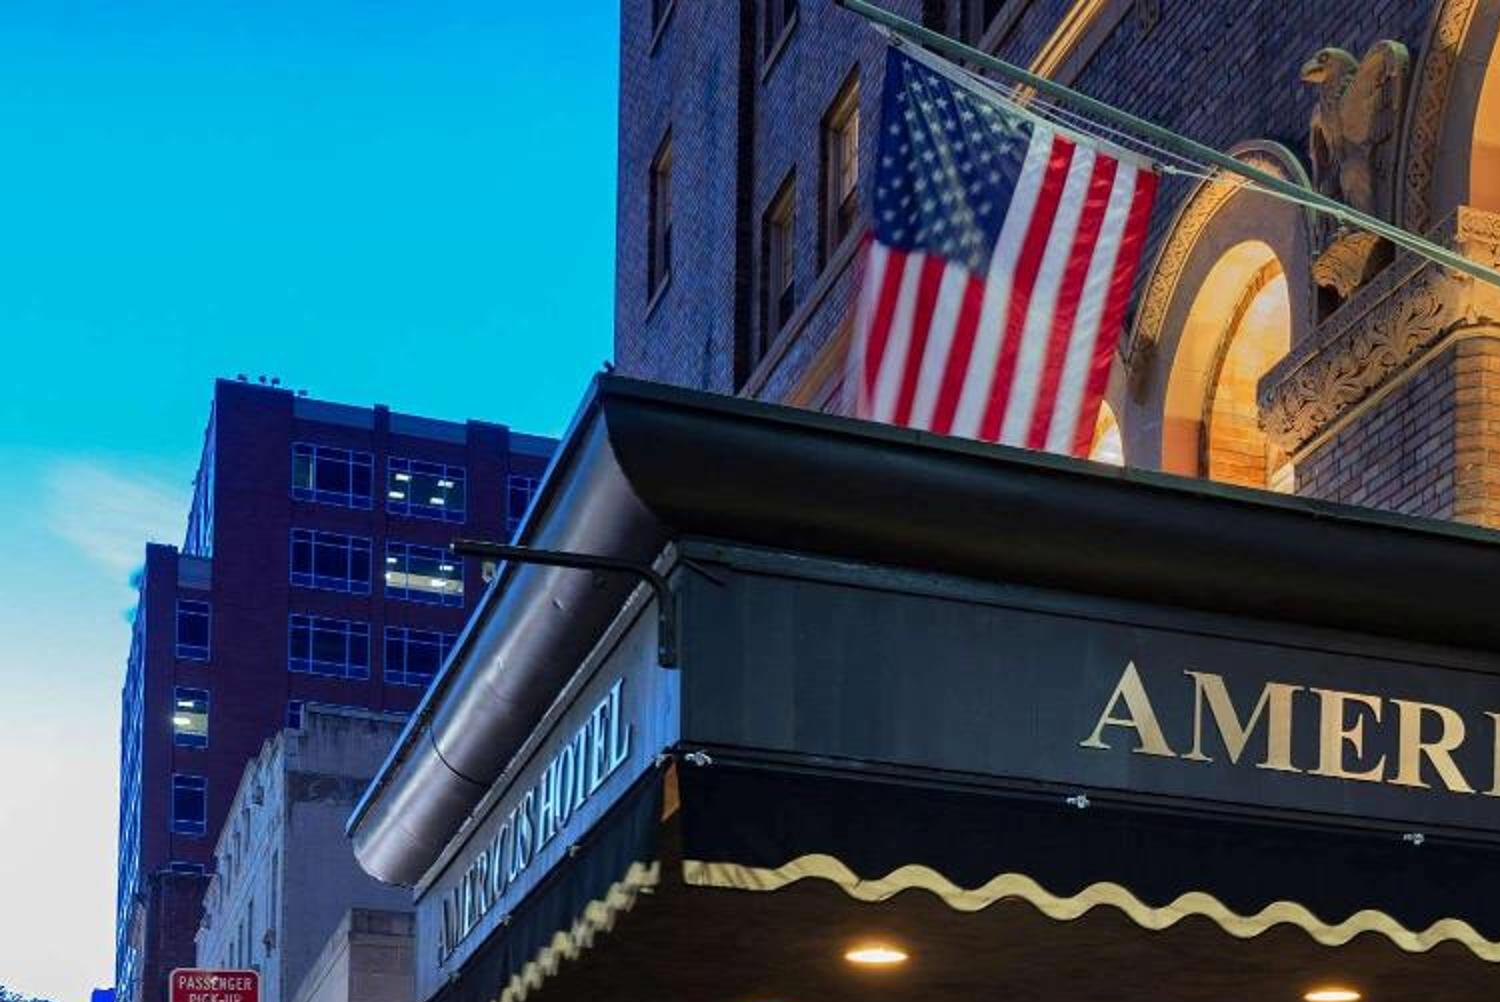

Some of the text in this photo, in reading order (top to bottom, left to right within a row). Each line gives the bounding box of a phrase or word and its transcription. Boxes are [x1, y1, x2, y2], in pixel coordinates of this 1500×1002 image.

[438, 677, 632, 968] AMERICUS HOTEL
[178, 975, 253, 991] PASSENGER
